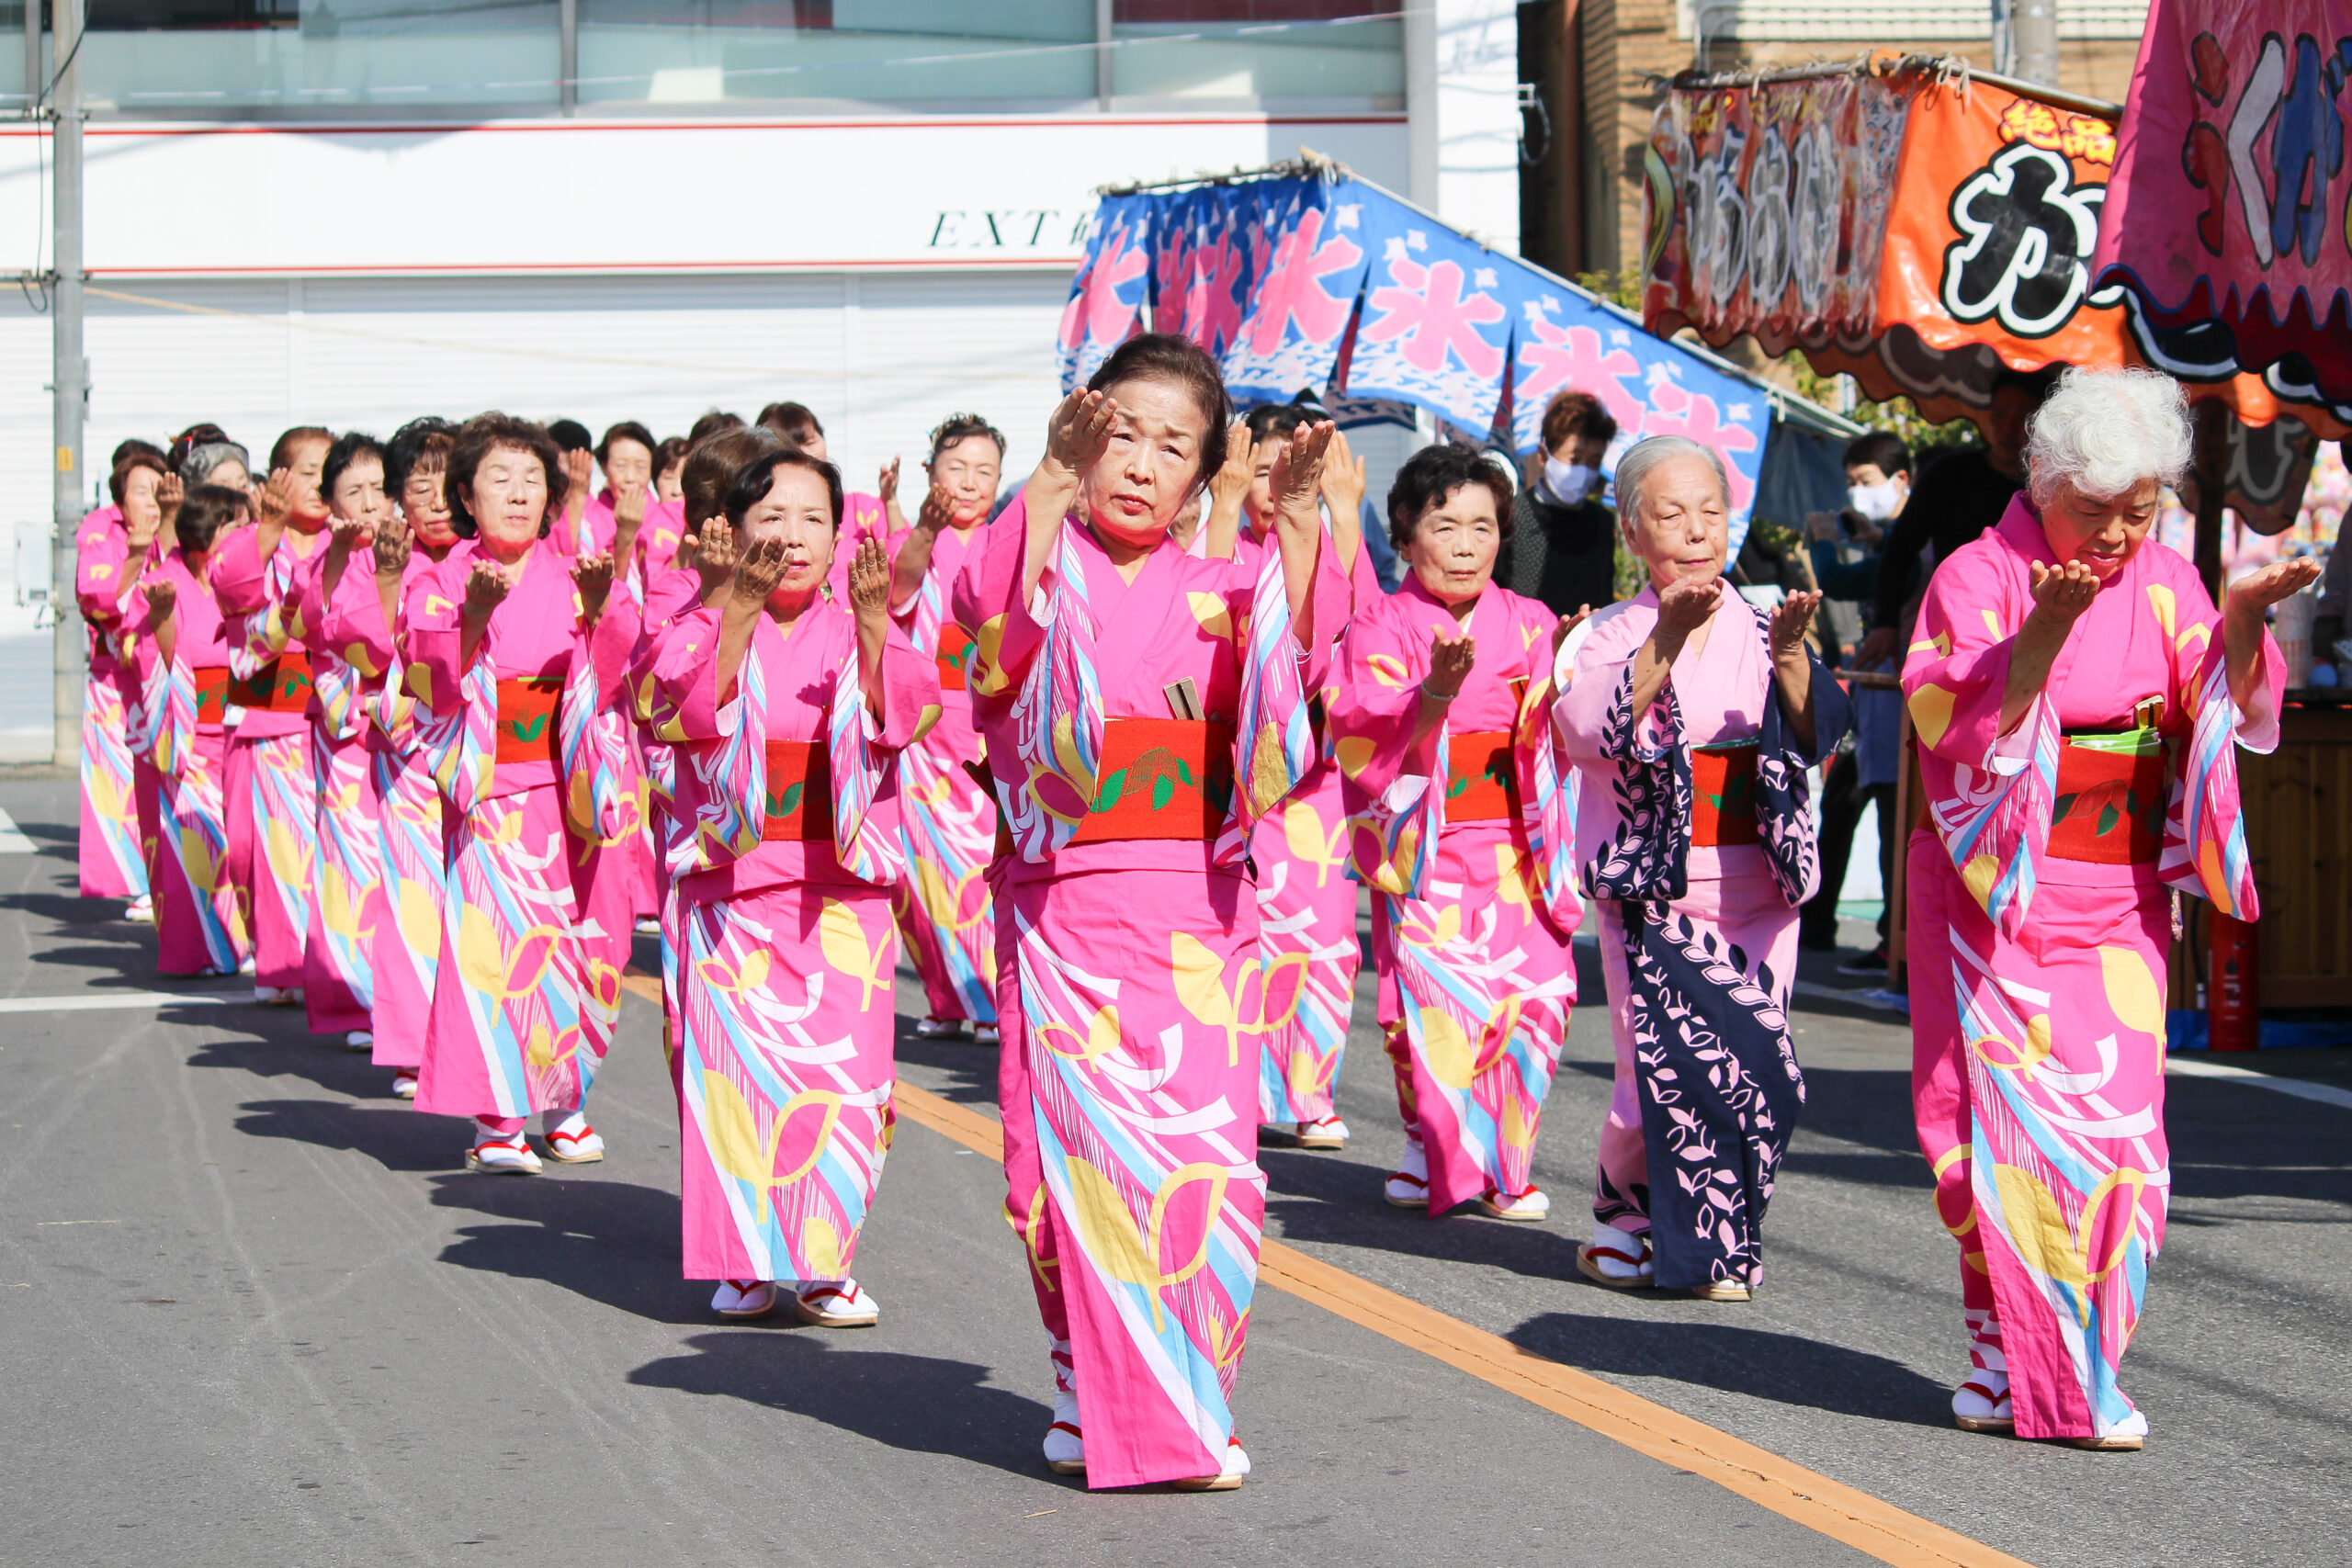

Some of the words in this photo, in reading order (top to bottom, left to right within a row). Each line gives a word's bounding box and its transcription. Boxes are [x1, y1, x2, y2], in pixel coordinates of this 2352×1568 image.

[1999, 97, 2117, 167] 絶品
[925, 209, 1060, 248] EXT
[1242, 204, 1364, 358] 氷
[1360, 257, 1507, 379] 氷
[1516, 317, 1647, 436] 氷
